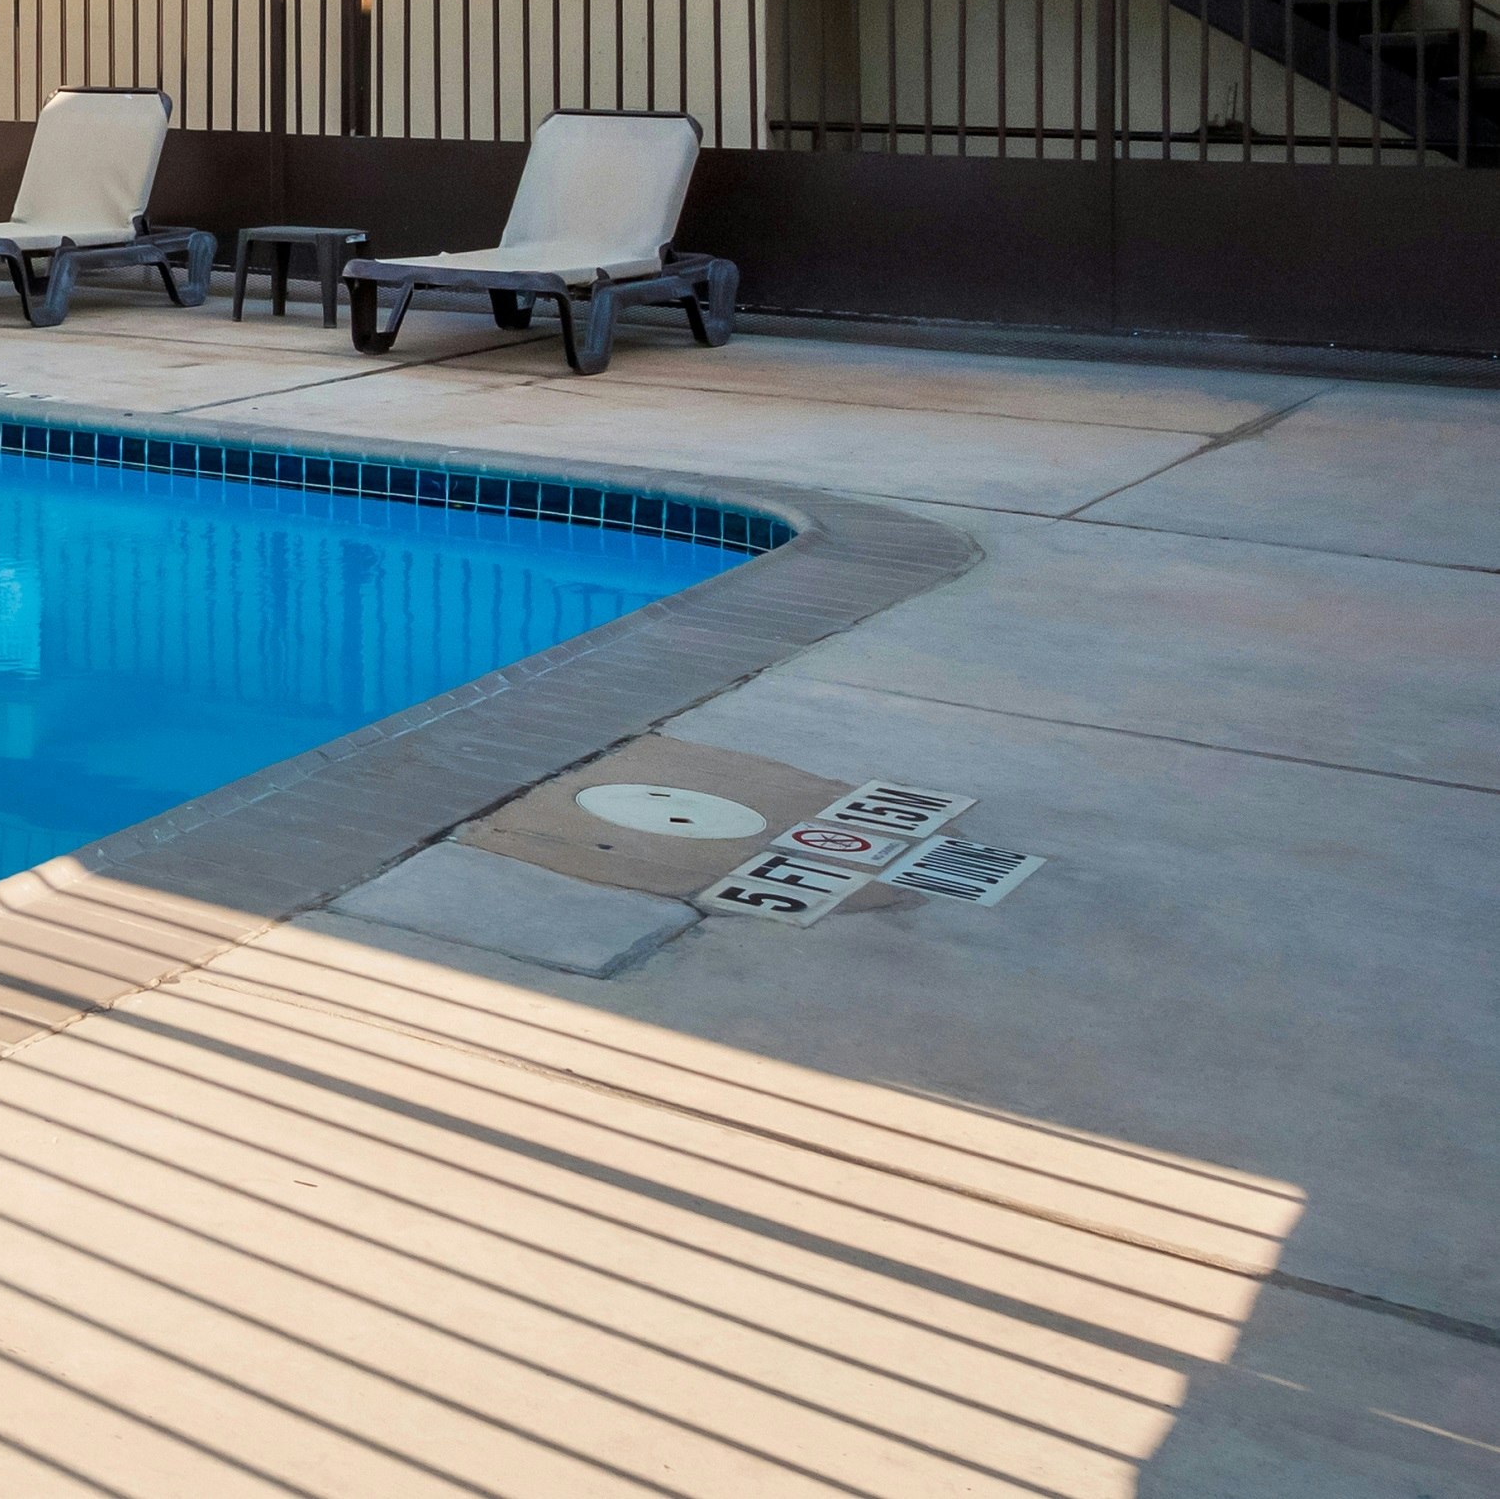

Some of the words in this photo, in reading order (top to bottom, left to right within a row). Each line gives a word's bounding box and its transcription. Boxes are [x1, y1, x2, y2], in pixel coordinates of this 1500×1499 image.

[748, 855, 852, 894] FT
[913, 840, 1028, 885] DIVING
[717, 887, 808, 913] 5
[892, 871, 987, 901] NO
